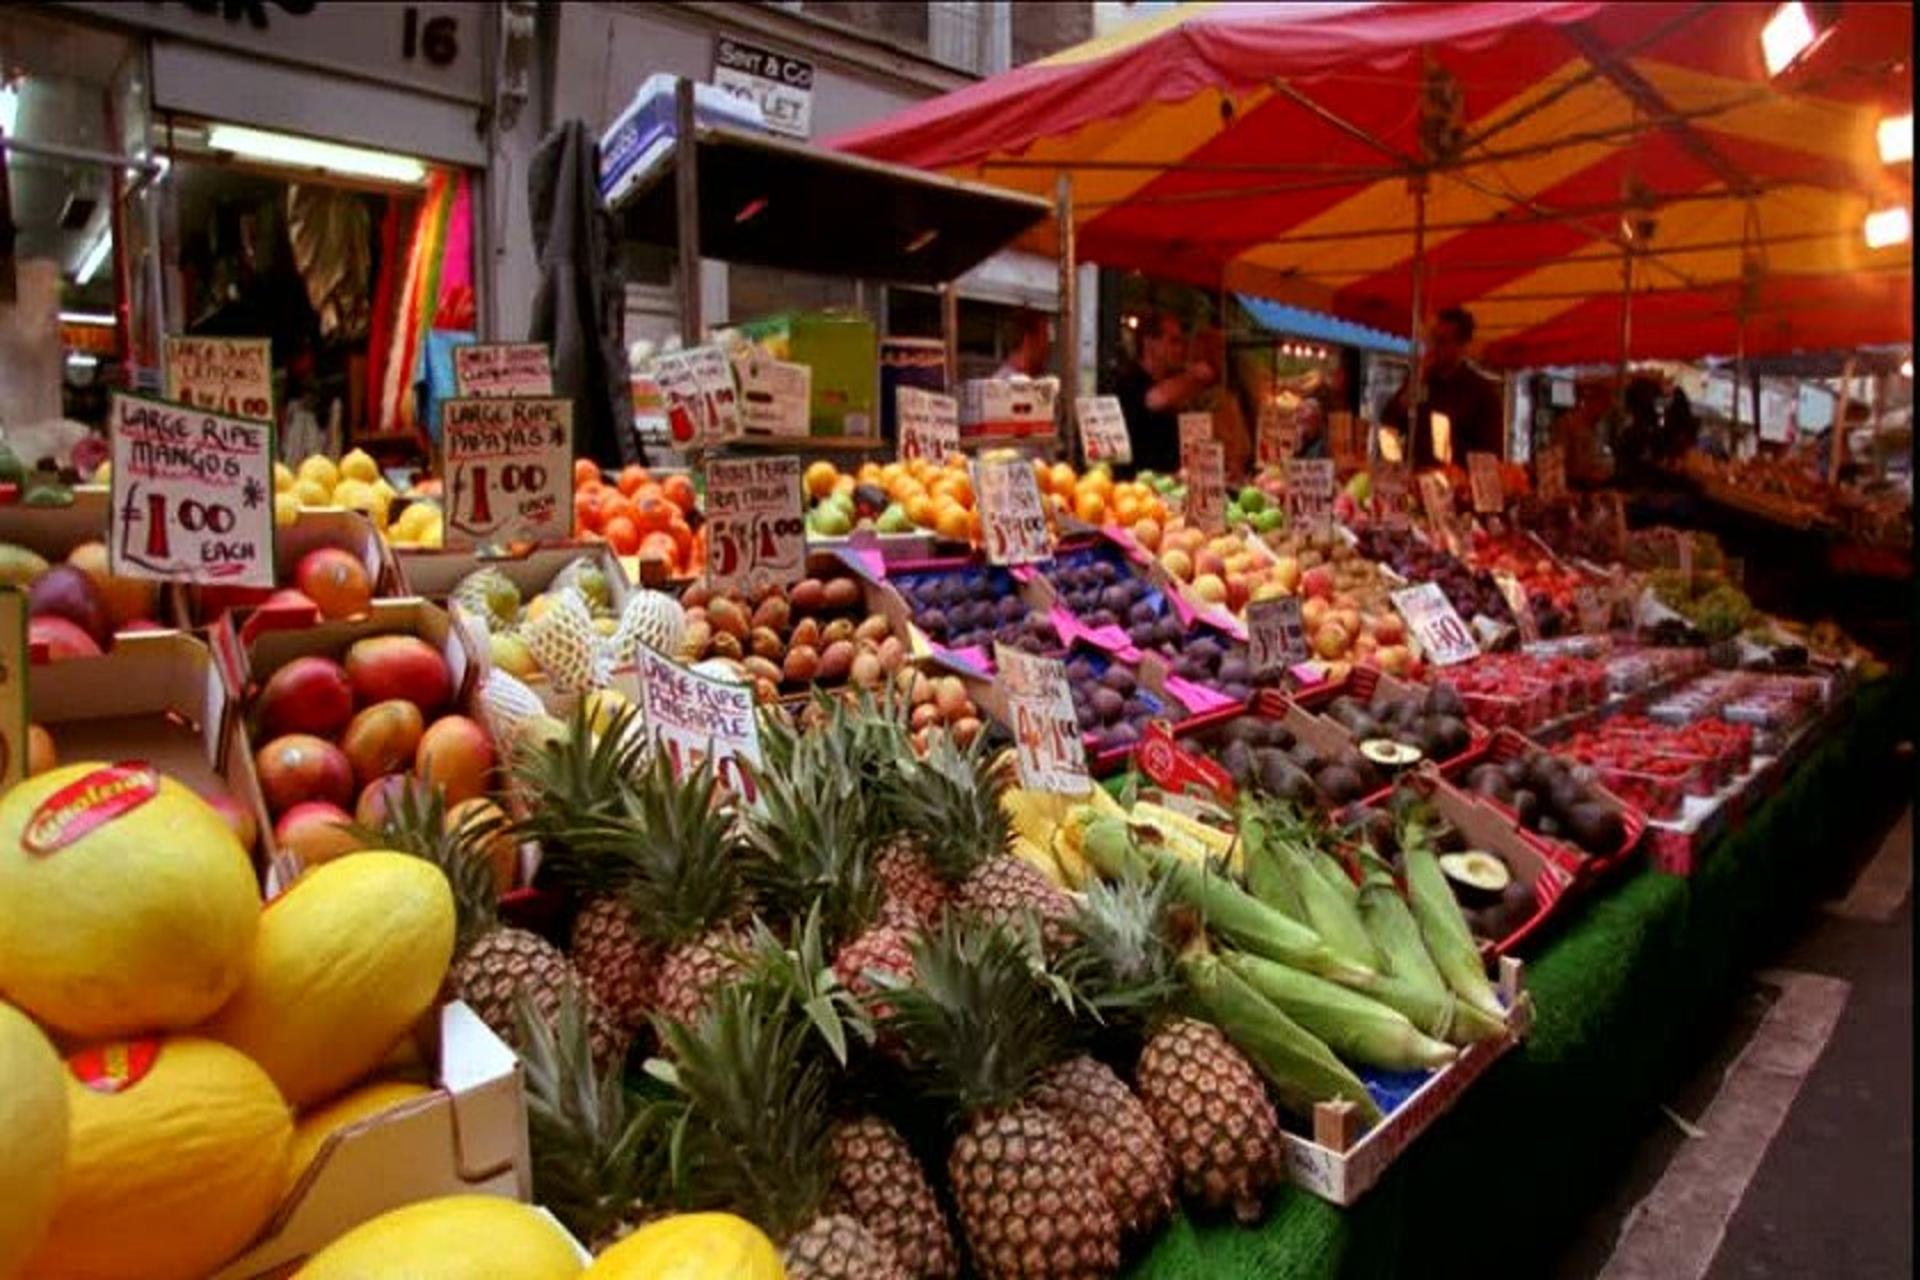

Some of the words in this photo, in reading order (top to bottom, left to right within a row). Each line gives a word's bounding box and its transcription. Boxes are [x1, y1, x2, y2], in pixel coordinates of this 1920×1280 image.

[402, 7, 458, 67] 16
[759, 91, 804, 122] LET
[121, 401, 190, 438] LARGE
[202, 418, 262, 451] RIPE
[450, 403, 506, 425] LARGE
[512, 402, 559, 426] RIPE
[450, 427, 545, 455] PAPAYAS
[131, 440, 241, 478] MANGOS
[202, 540, 256, 562] EACH
[712, 522, 738, 577] 5
